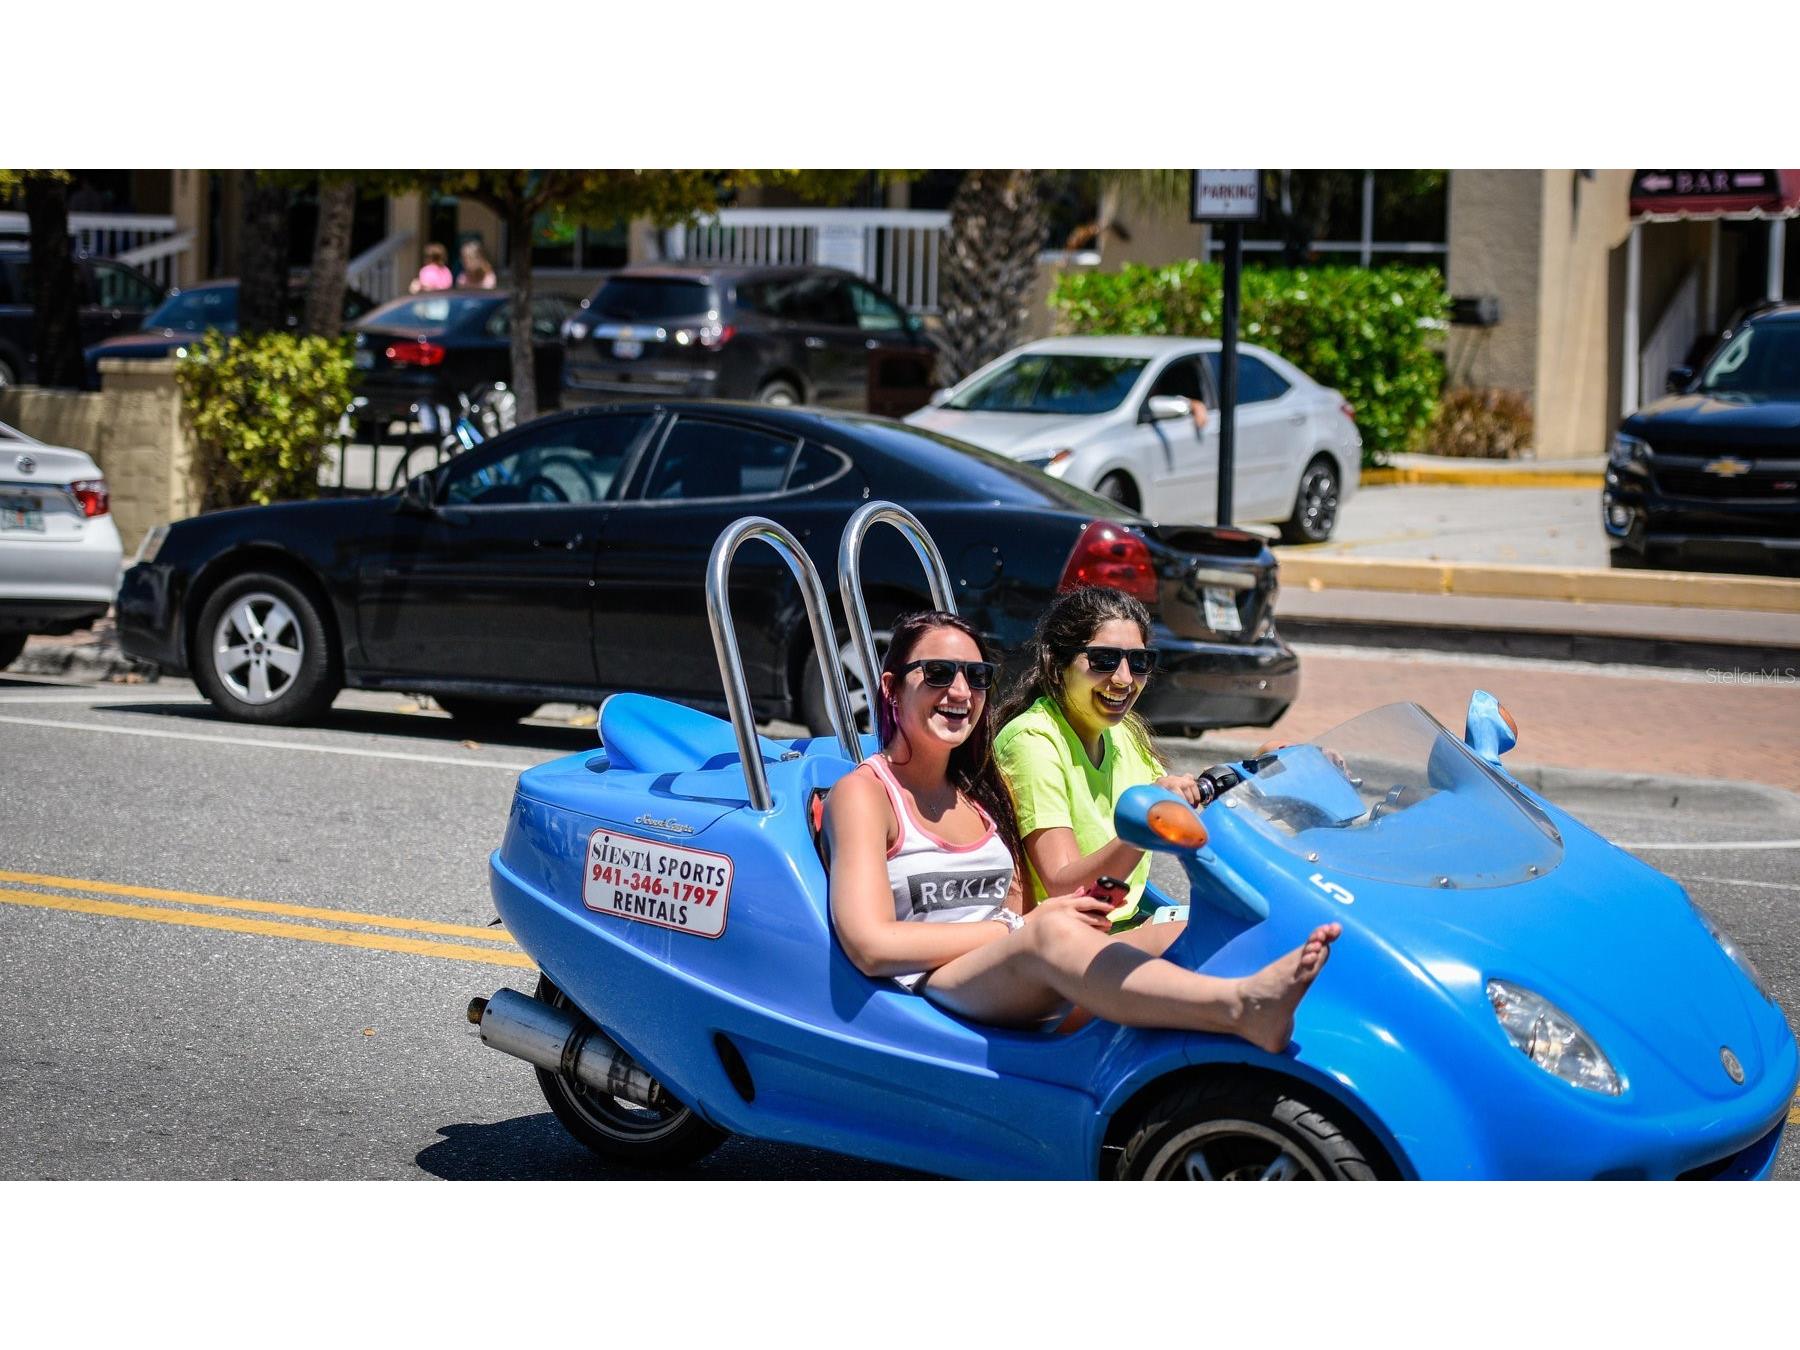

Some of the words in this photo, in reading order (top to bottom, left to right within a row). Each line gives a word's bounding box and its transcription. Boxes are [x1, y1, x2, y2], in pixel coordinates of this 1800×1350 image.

[1202, 184, 1257, 200] PARKING
[1675, 171, 1730, 193] BAR
[592, 864, 719, 907] 941-346-1797
[658, 855, 726, 887] SPORTS
[920, 877, 1006, 905] RCKLS
[1308, 872, 1355, 905] 5
[613, 890, 688, 925] RENTALS
